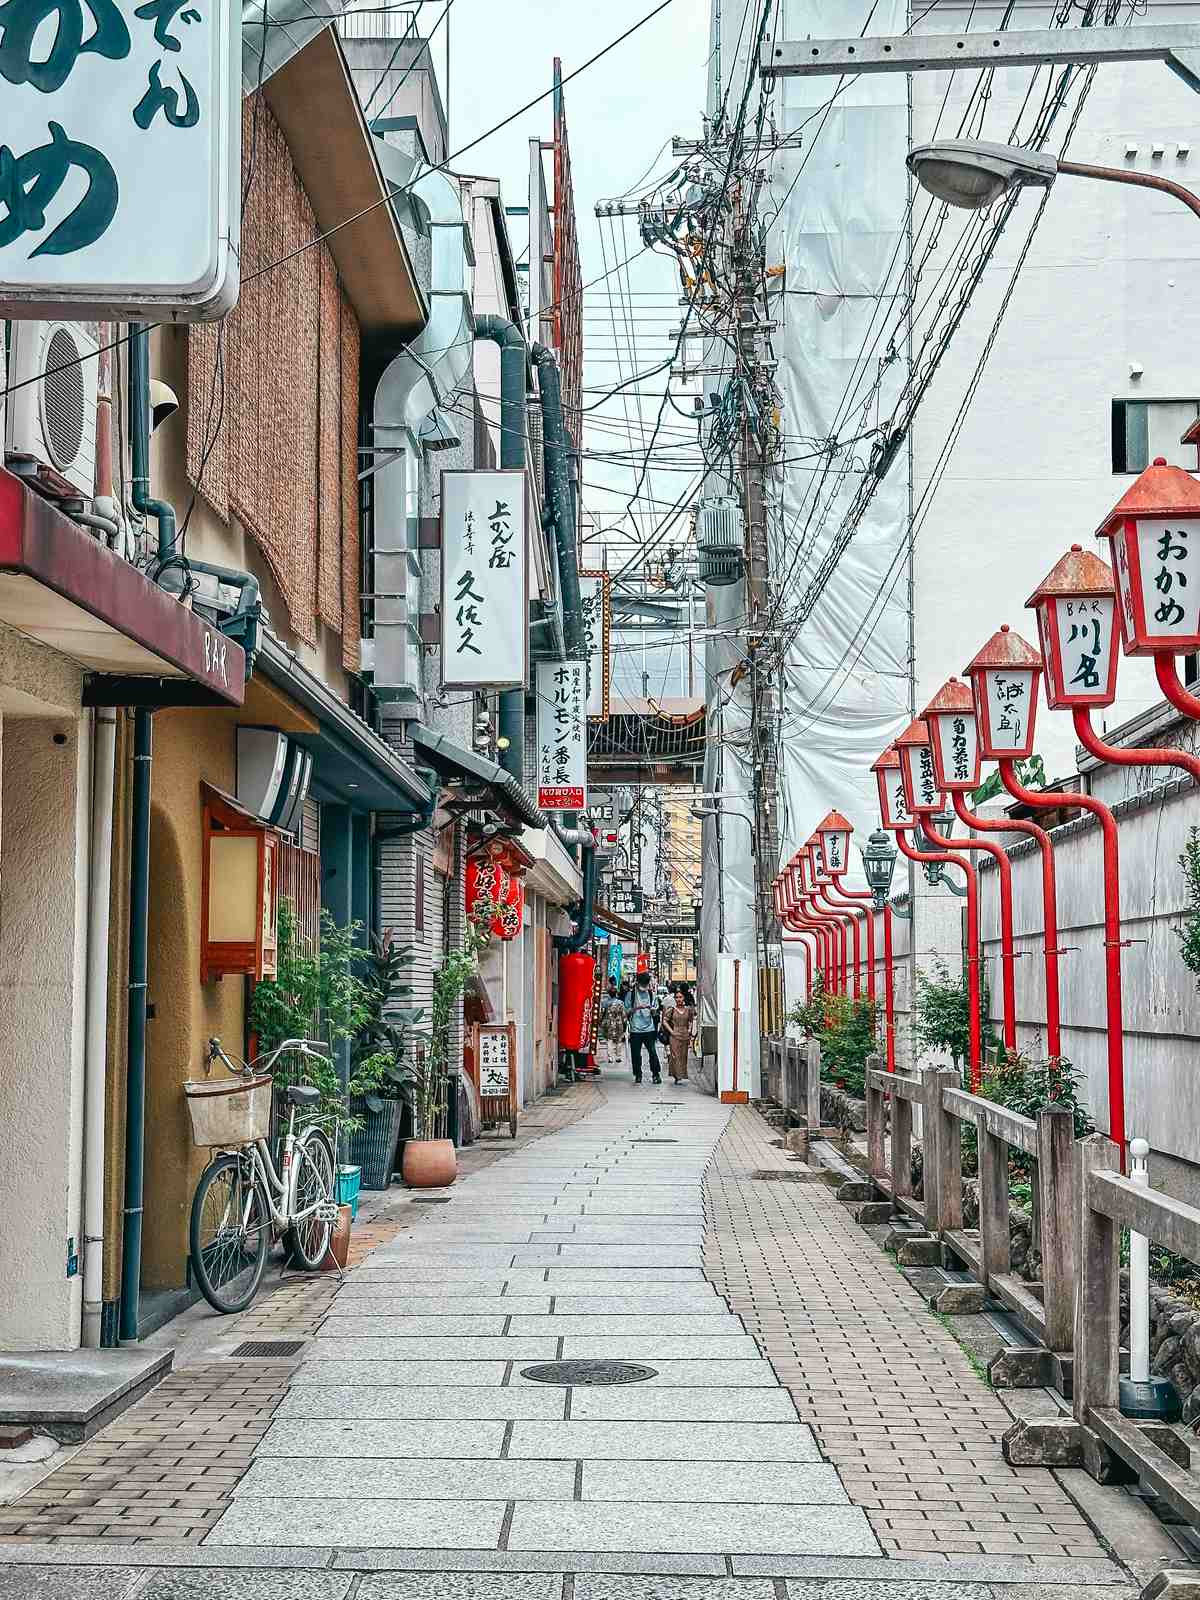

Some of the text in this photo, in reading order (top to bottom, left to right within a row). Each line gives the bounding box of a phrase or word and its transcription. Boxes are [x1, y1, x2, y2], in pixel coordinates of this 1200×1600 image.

[462, 511, 476, 556] 法善寺
[487, 500, 516, 569] 上かん屋
[454, 570, 485, 655] 久佐久
[1066, 600, 1103, 617] BAR
[1154, 529, 1188, 627] おかめ
[204, 631, 228, 688] BAR
[1067, 618, 1102, 688] 川名
[553, 667, 571, 785] ホルモン番長
[541, 745, 552, 786] なんば店
